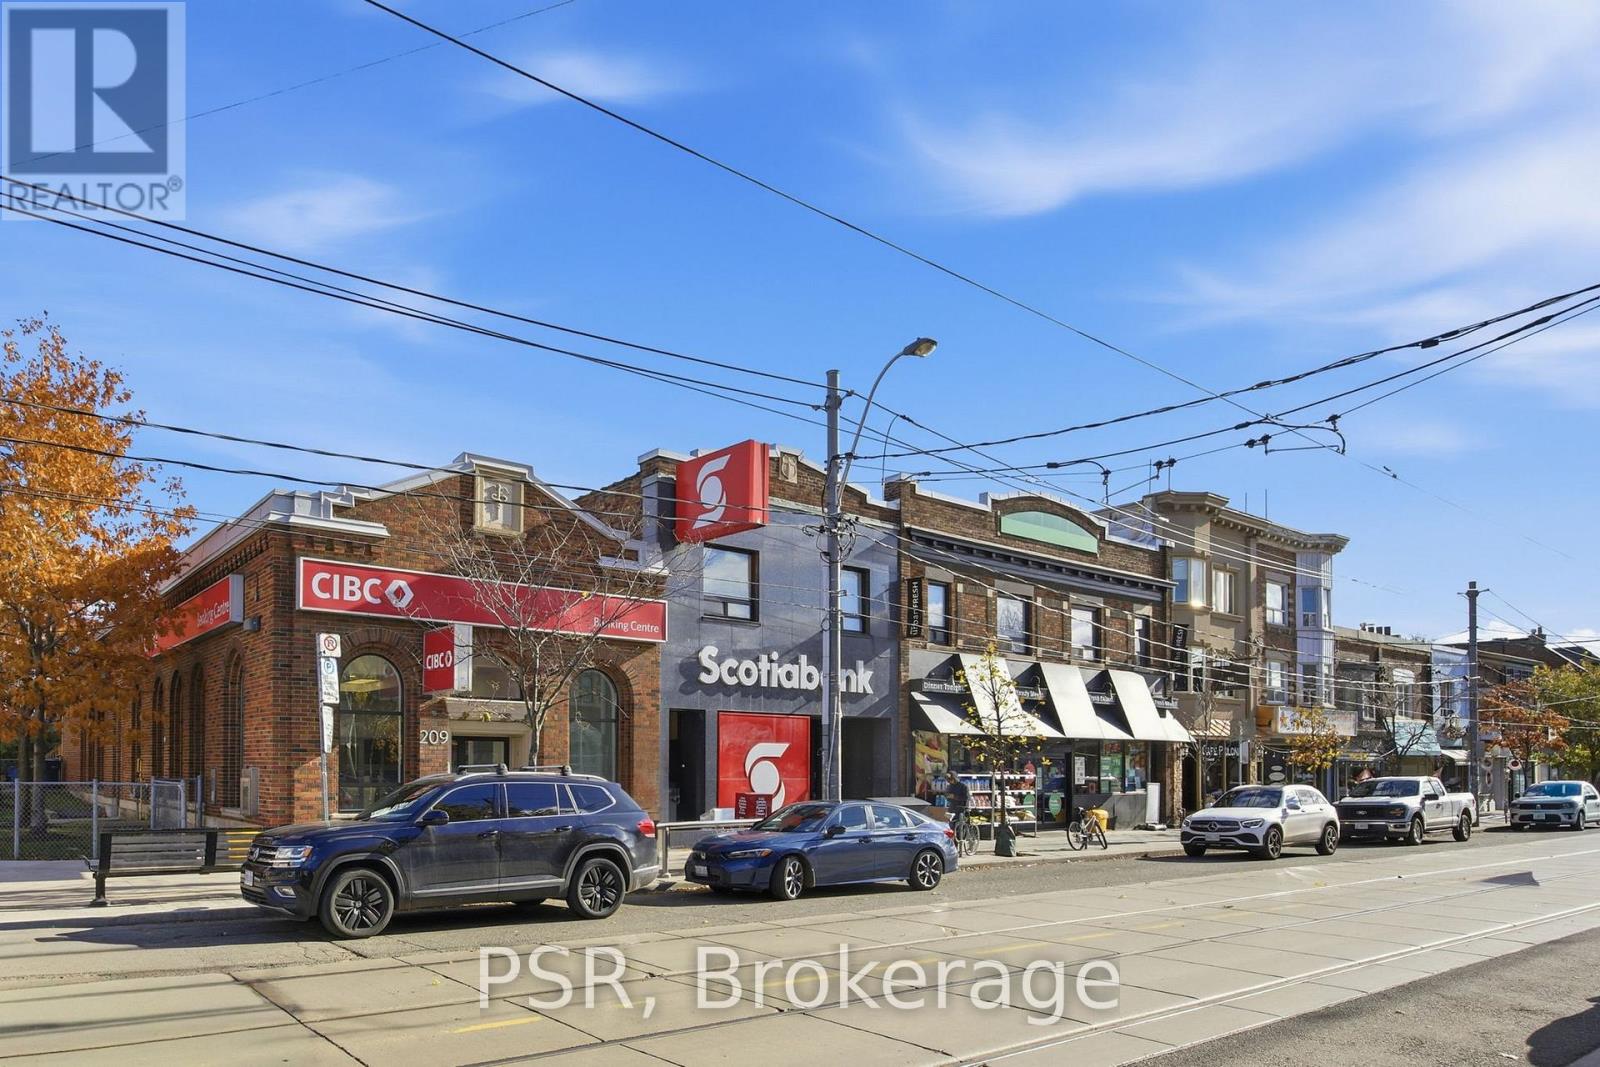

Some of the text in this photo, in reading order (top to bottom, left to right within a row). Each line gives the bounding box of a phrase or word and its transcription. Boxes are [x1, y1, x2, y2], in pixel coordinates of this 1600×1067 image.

[311, 572, 382, 604] CIBC
[630, 620, 660, 633] Centre
[426, 652, 445, 670] CIBC
[698, 645, 874, 694] Scotiabnk
[420, 729, 448, 744] 209
